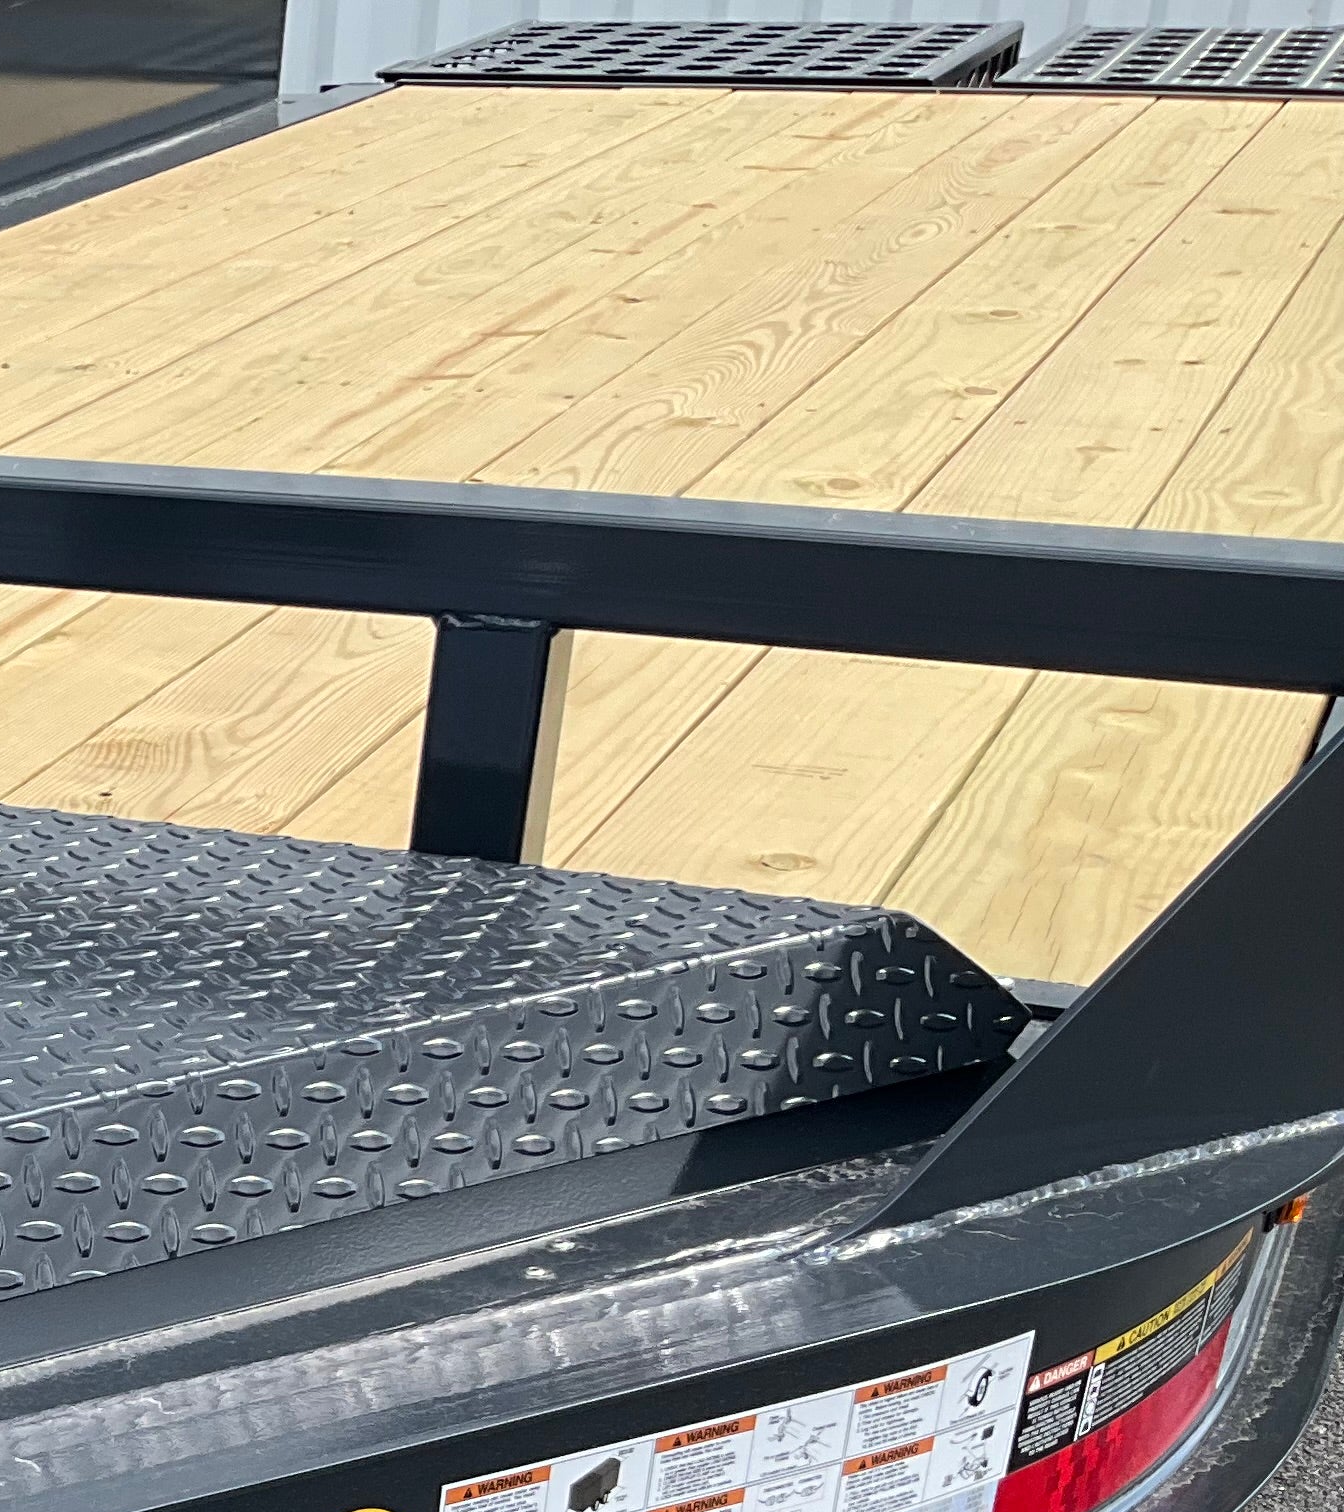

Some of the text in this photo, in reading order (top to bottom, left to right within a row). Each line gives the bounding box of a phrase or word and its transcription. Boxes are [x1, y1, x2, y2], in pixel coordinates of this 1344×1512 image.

[1128, 1311, 1169, 1344] CAUTION
[1043, 1355, 1088, 1385] DANGER
[884, 1372, 932, 1394] WARNING
[686, 1421, 740, 1444] WARNING
[871, 1442, 918, 1465] WARNING
[477, 1471, 533, 1495] WARNING
